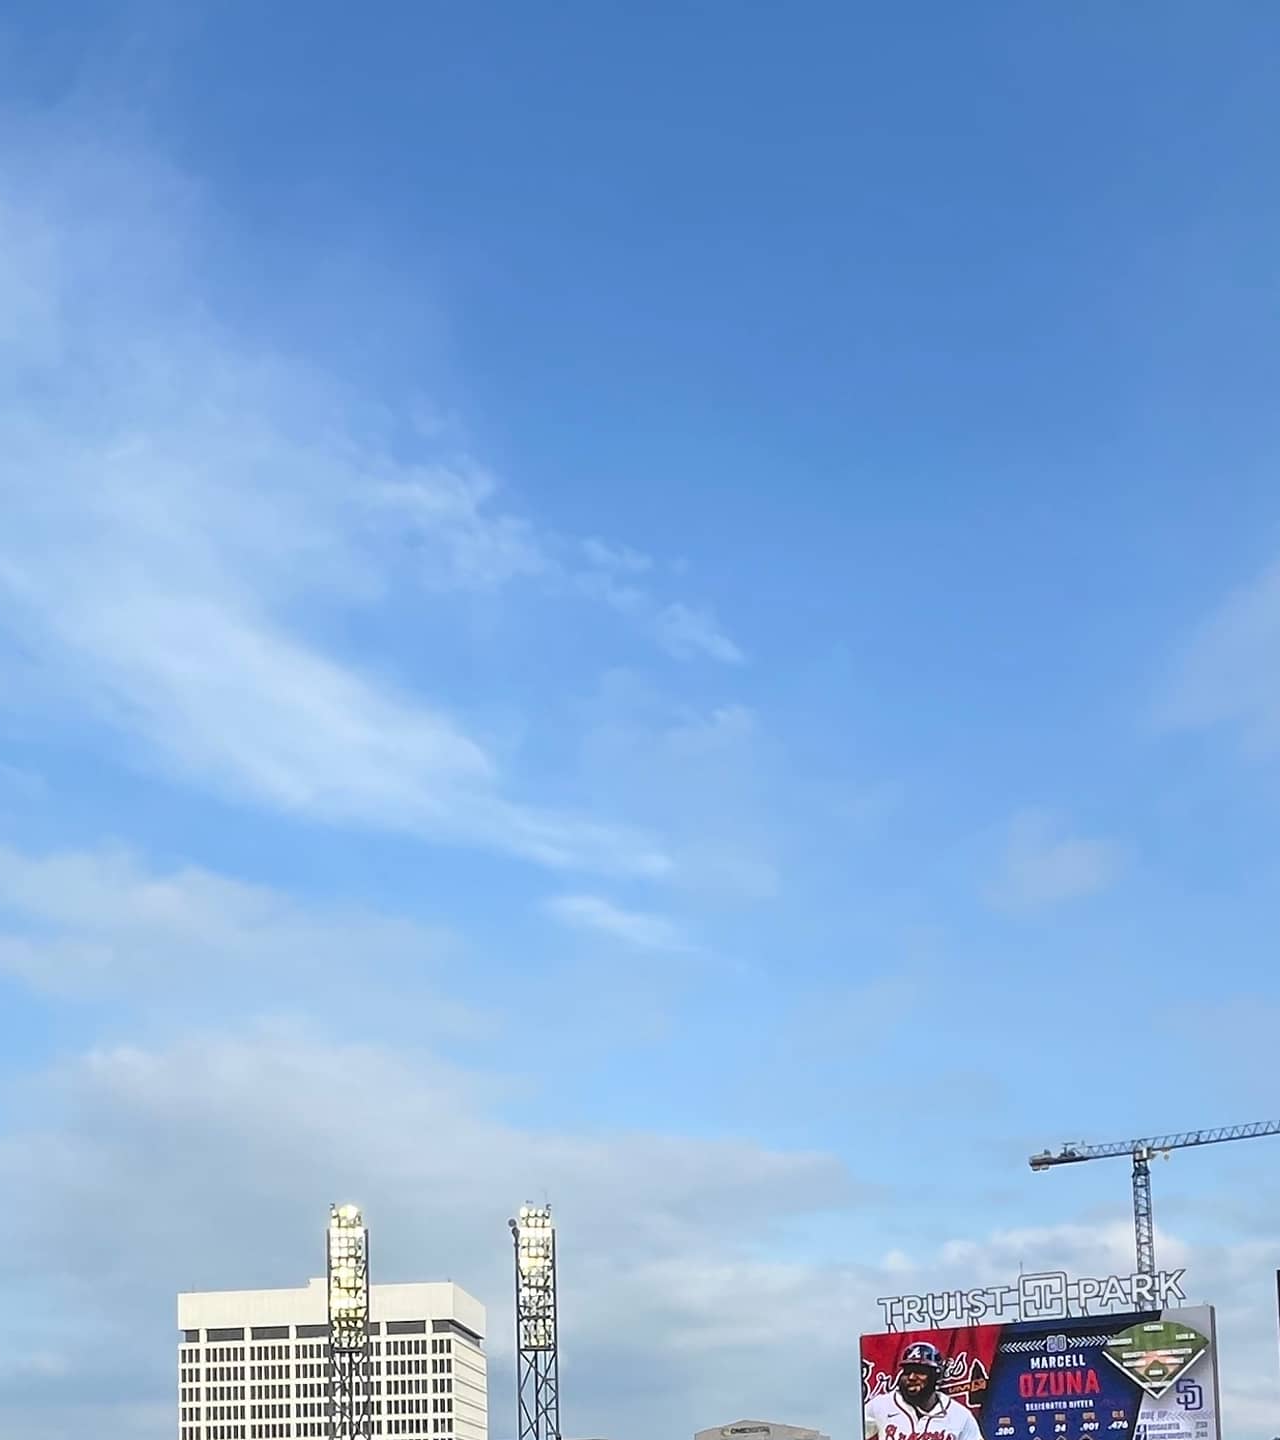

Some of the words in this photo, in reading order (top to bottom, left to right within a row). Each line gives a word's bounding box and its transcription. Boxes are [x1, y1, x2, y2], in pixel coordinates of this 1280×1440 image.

[878, 1286, 1009, 1325] TRUIST
[1078, 1269, 1186, 1307] PARK
[1030, 1355, 1086, 1370] MARCELL
[1019, 1370, 1100, 1397] OZUNA
